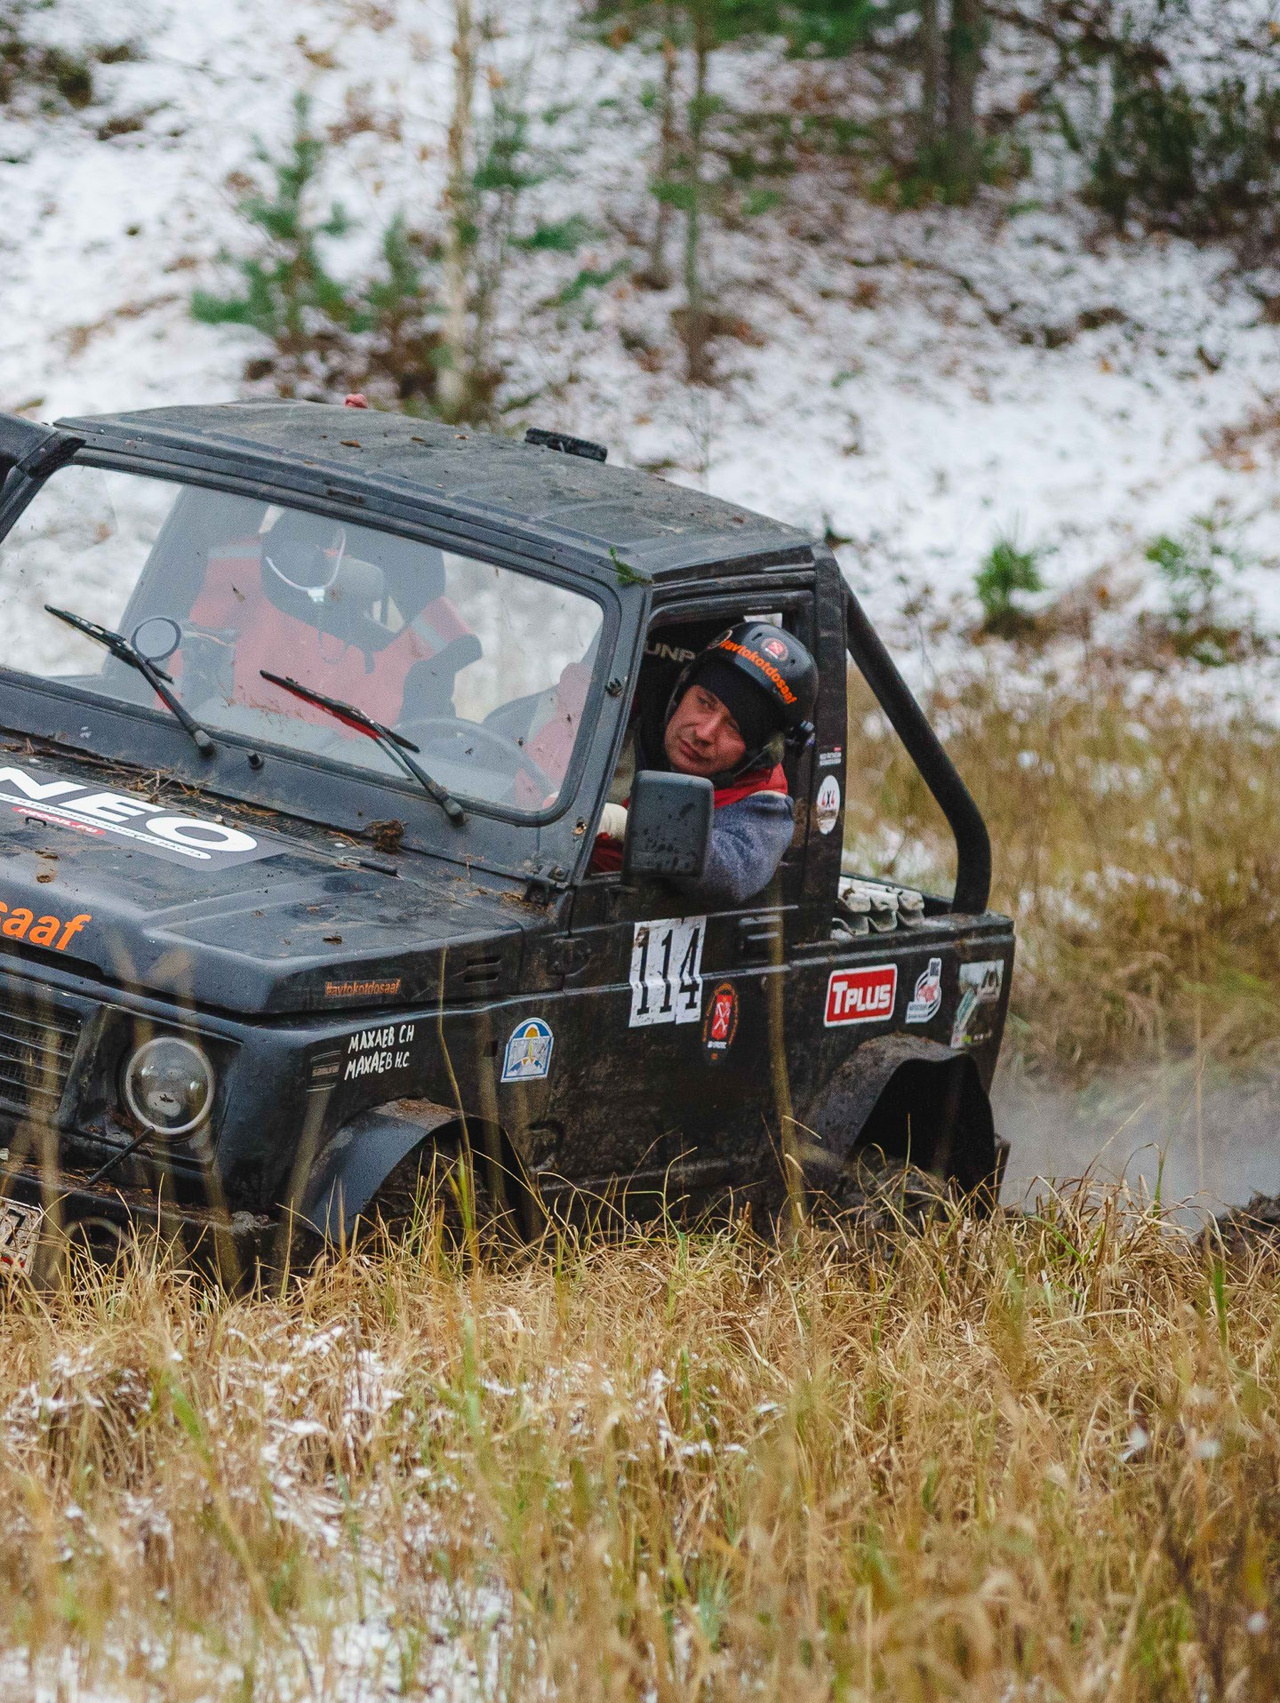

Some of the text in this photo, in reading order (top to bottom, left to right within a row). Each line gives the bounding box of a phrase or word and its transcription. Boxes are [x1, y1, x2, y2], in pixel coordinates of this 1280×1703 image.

[635, 926, 701, 1015] 114
[324, 978, 402, 996] #avtokotdosaaf
[348, 1026, 395, 1054] МАХАЕВ
[344, 1051, 393, 1081] МАХАЕВ
